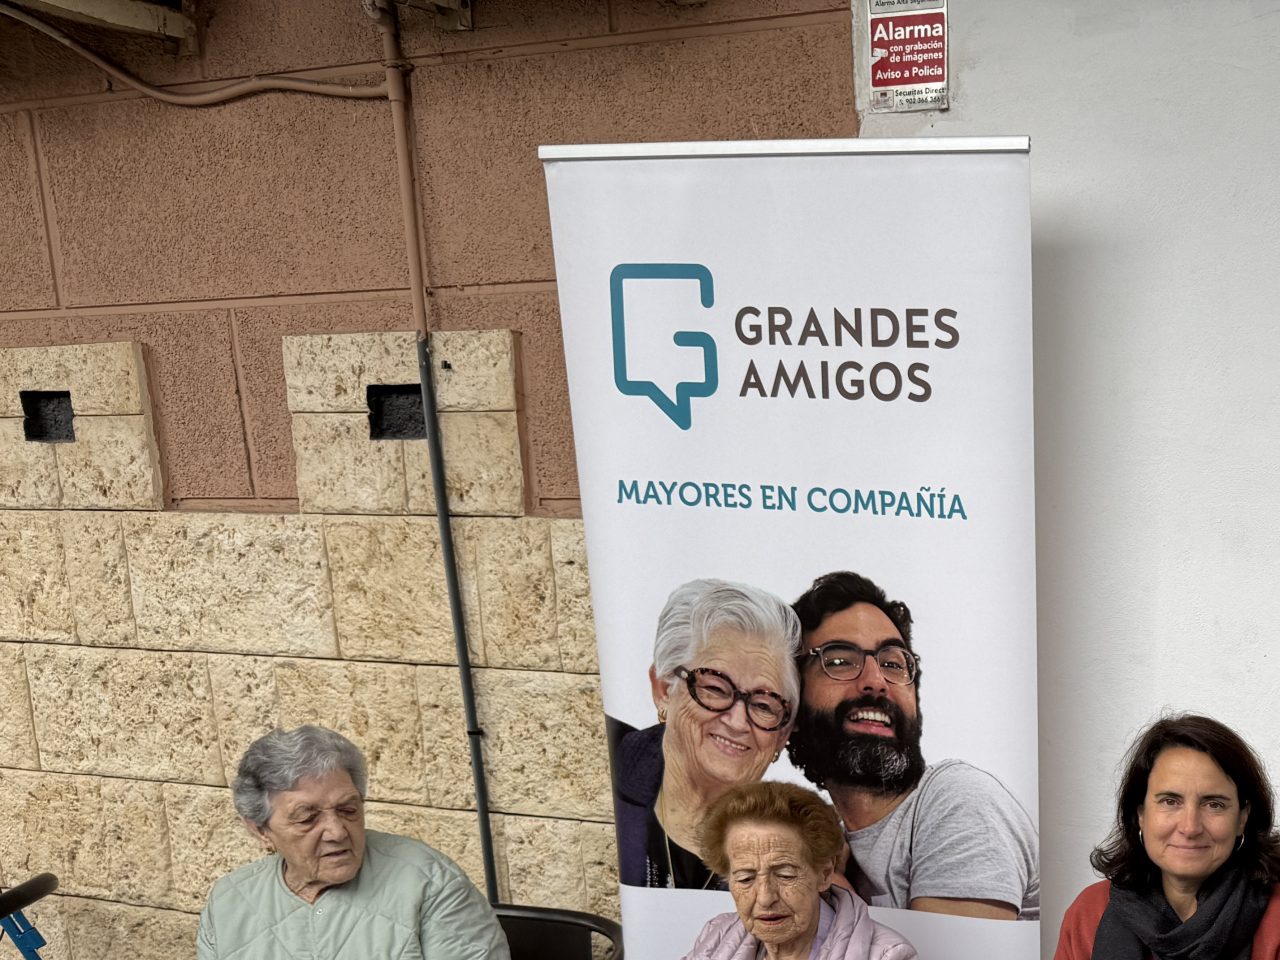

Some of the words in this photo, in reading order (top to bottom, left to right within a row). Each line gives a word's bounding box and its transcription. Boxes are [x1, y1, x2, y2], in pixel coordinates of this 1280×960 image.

[874, 22, 943, 41] Alarma
[905, 41, 943, 53] grabación
[890, 53, 900, 62] de
[903, 52, 943, 63] imágenes
[876, 69, 901, 79] Aviso
[912, 66, 942, 76] Policía
[735, 306, 960, 349] GRANDES
[739, 358, 932, 402] AMIGOS
[617, 479, 752, 509] MAYORES
[760, 485, 797, 511] EN
[807, 487, 967, 520] COMPAÑÍA
